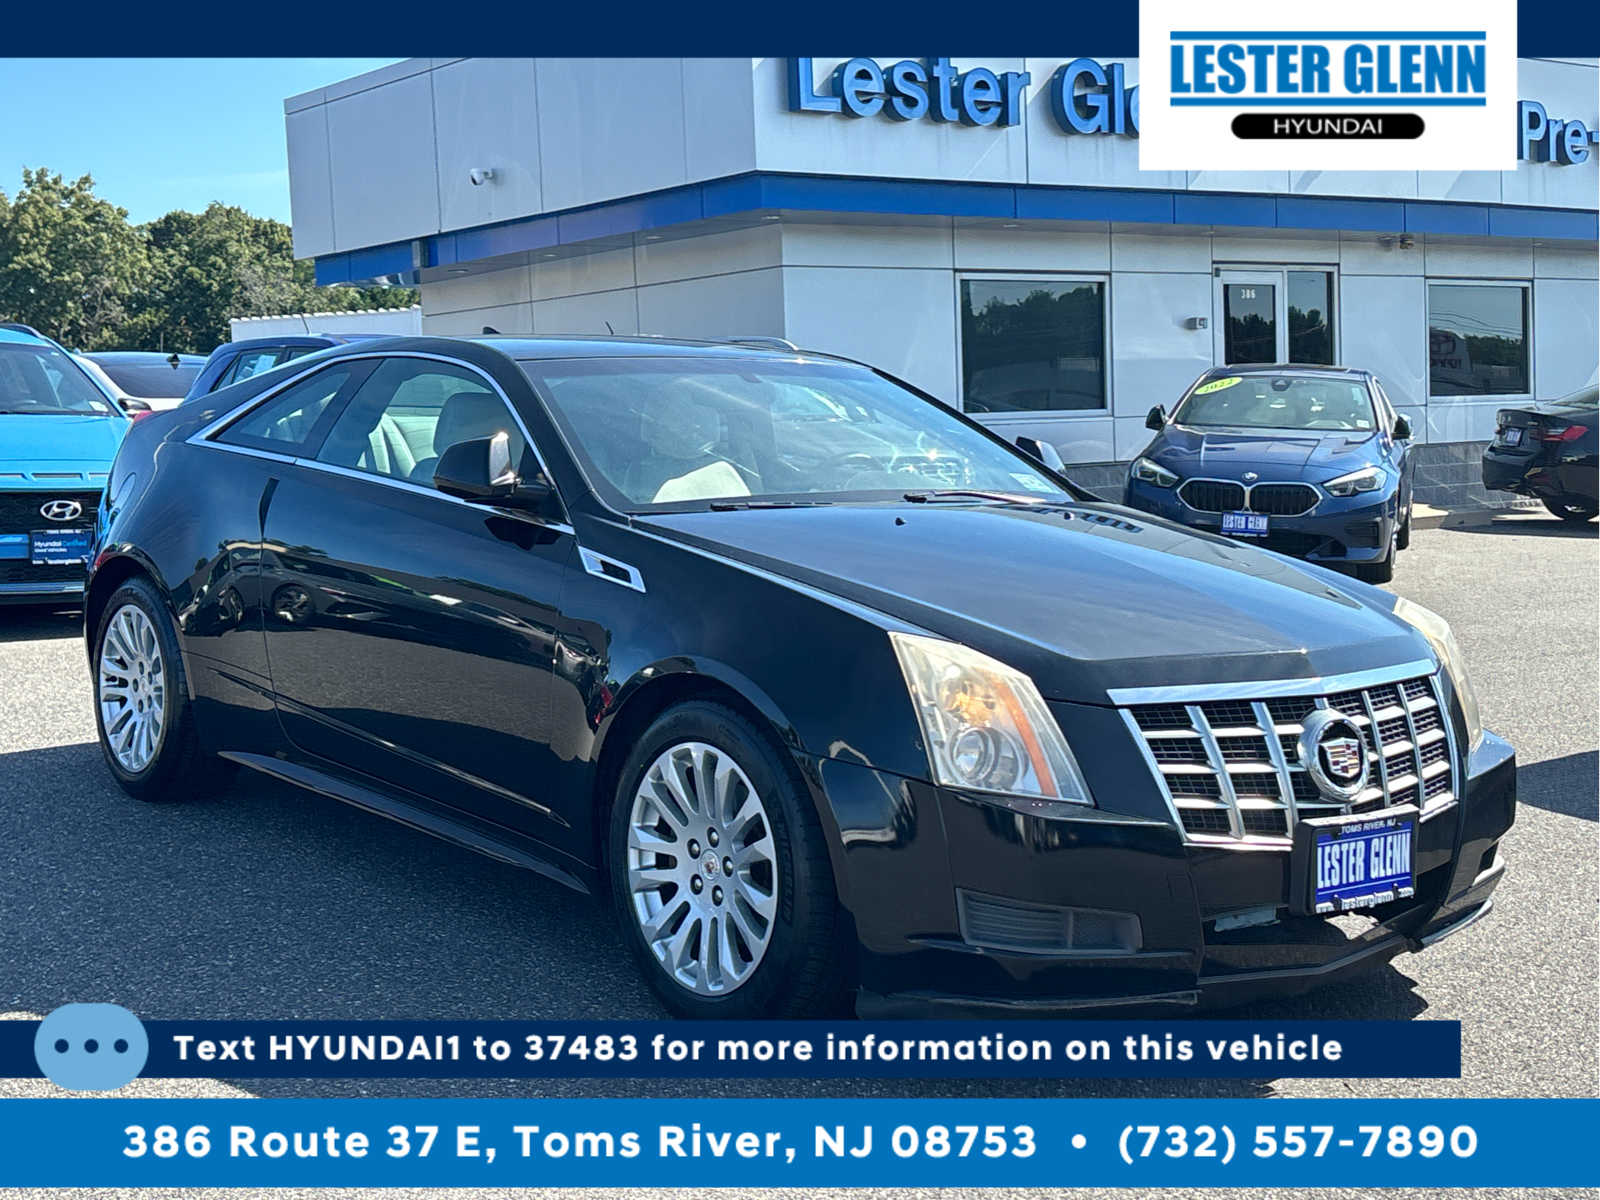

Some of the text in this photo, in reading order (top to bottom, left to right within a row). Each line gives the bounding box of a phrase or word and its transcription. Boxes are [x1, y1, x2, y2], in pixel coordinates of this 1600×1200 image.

[789, 57, 1031, 127] Lester
[1050, 57, 1139, 135] Gl
[1240, 288, 1256, 300] 386
[1341, 823, 1363, 834] TOMS
[1386, 817, 1397, 828] NJ
[1316, 831, 1412, 890] LESTER GLENN
